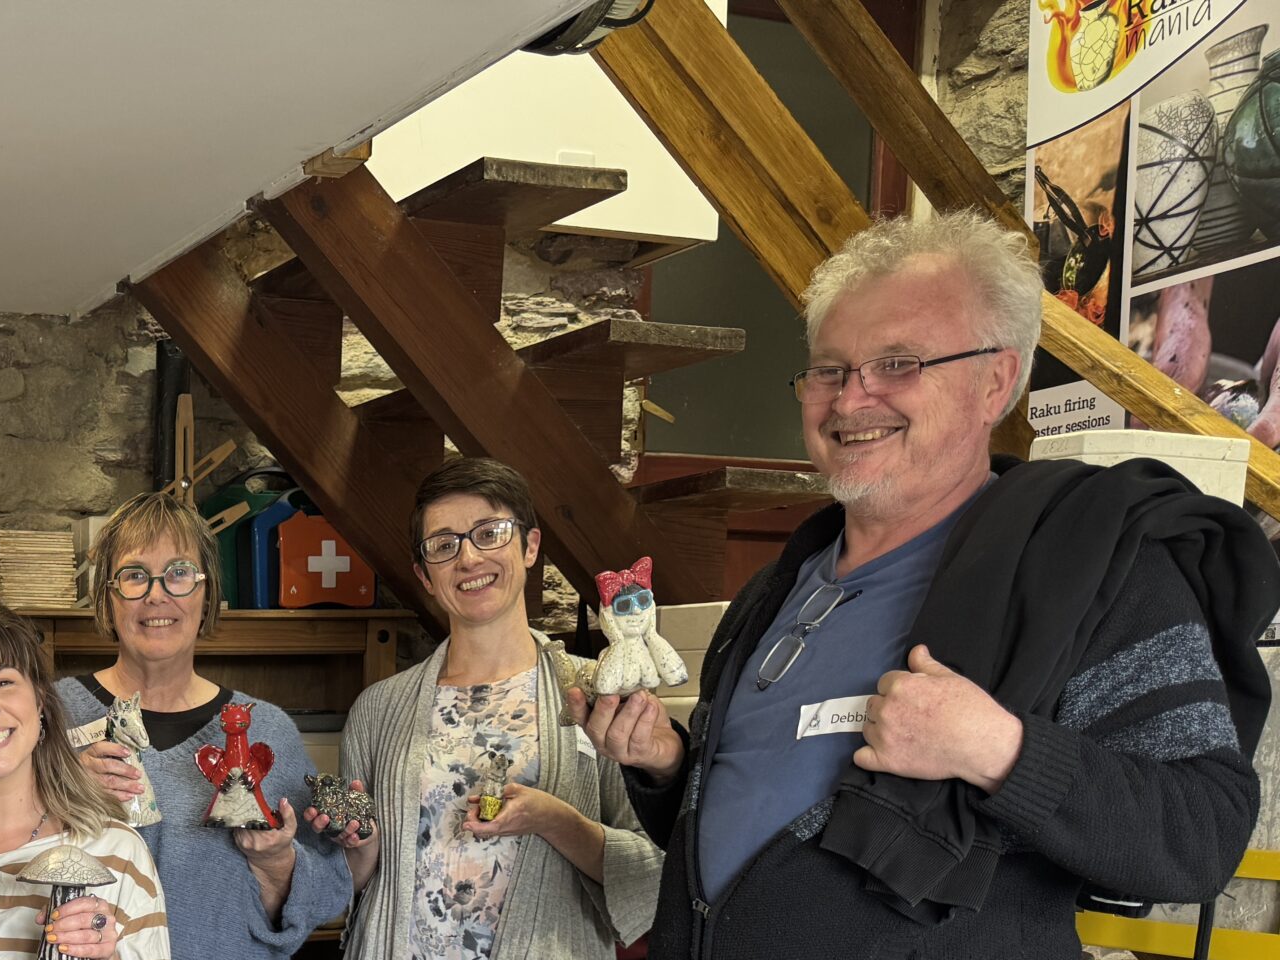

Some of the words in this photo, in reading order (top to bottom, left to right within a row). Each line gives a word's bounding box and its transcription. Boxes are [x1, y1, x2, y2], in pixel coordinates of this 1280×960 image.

[1125, 0, 1211, 59] mania
[1029, 403, 1061, 420] Raku
[1064, 396, 1096, 413] firing
[1034, 424, 1063, 438] aster
[1065, 414, 1111, 434] sessions
